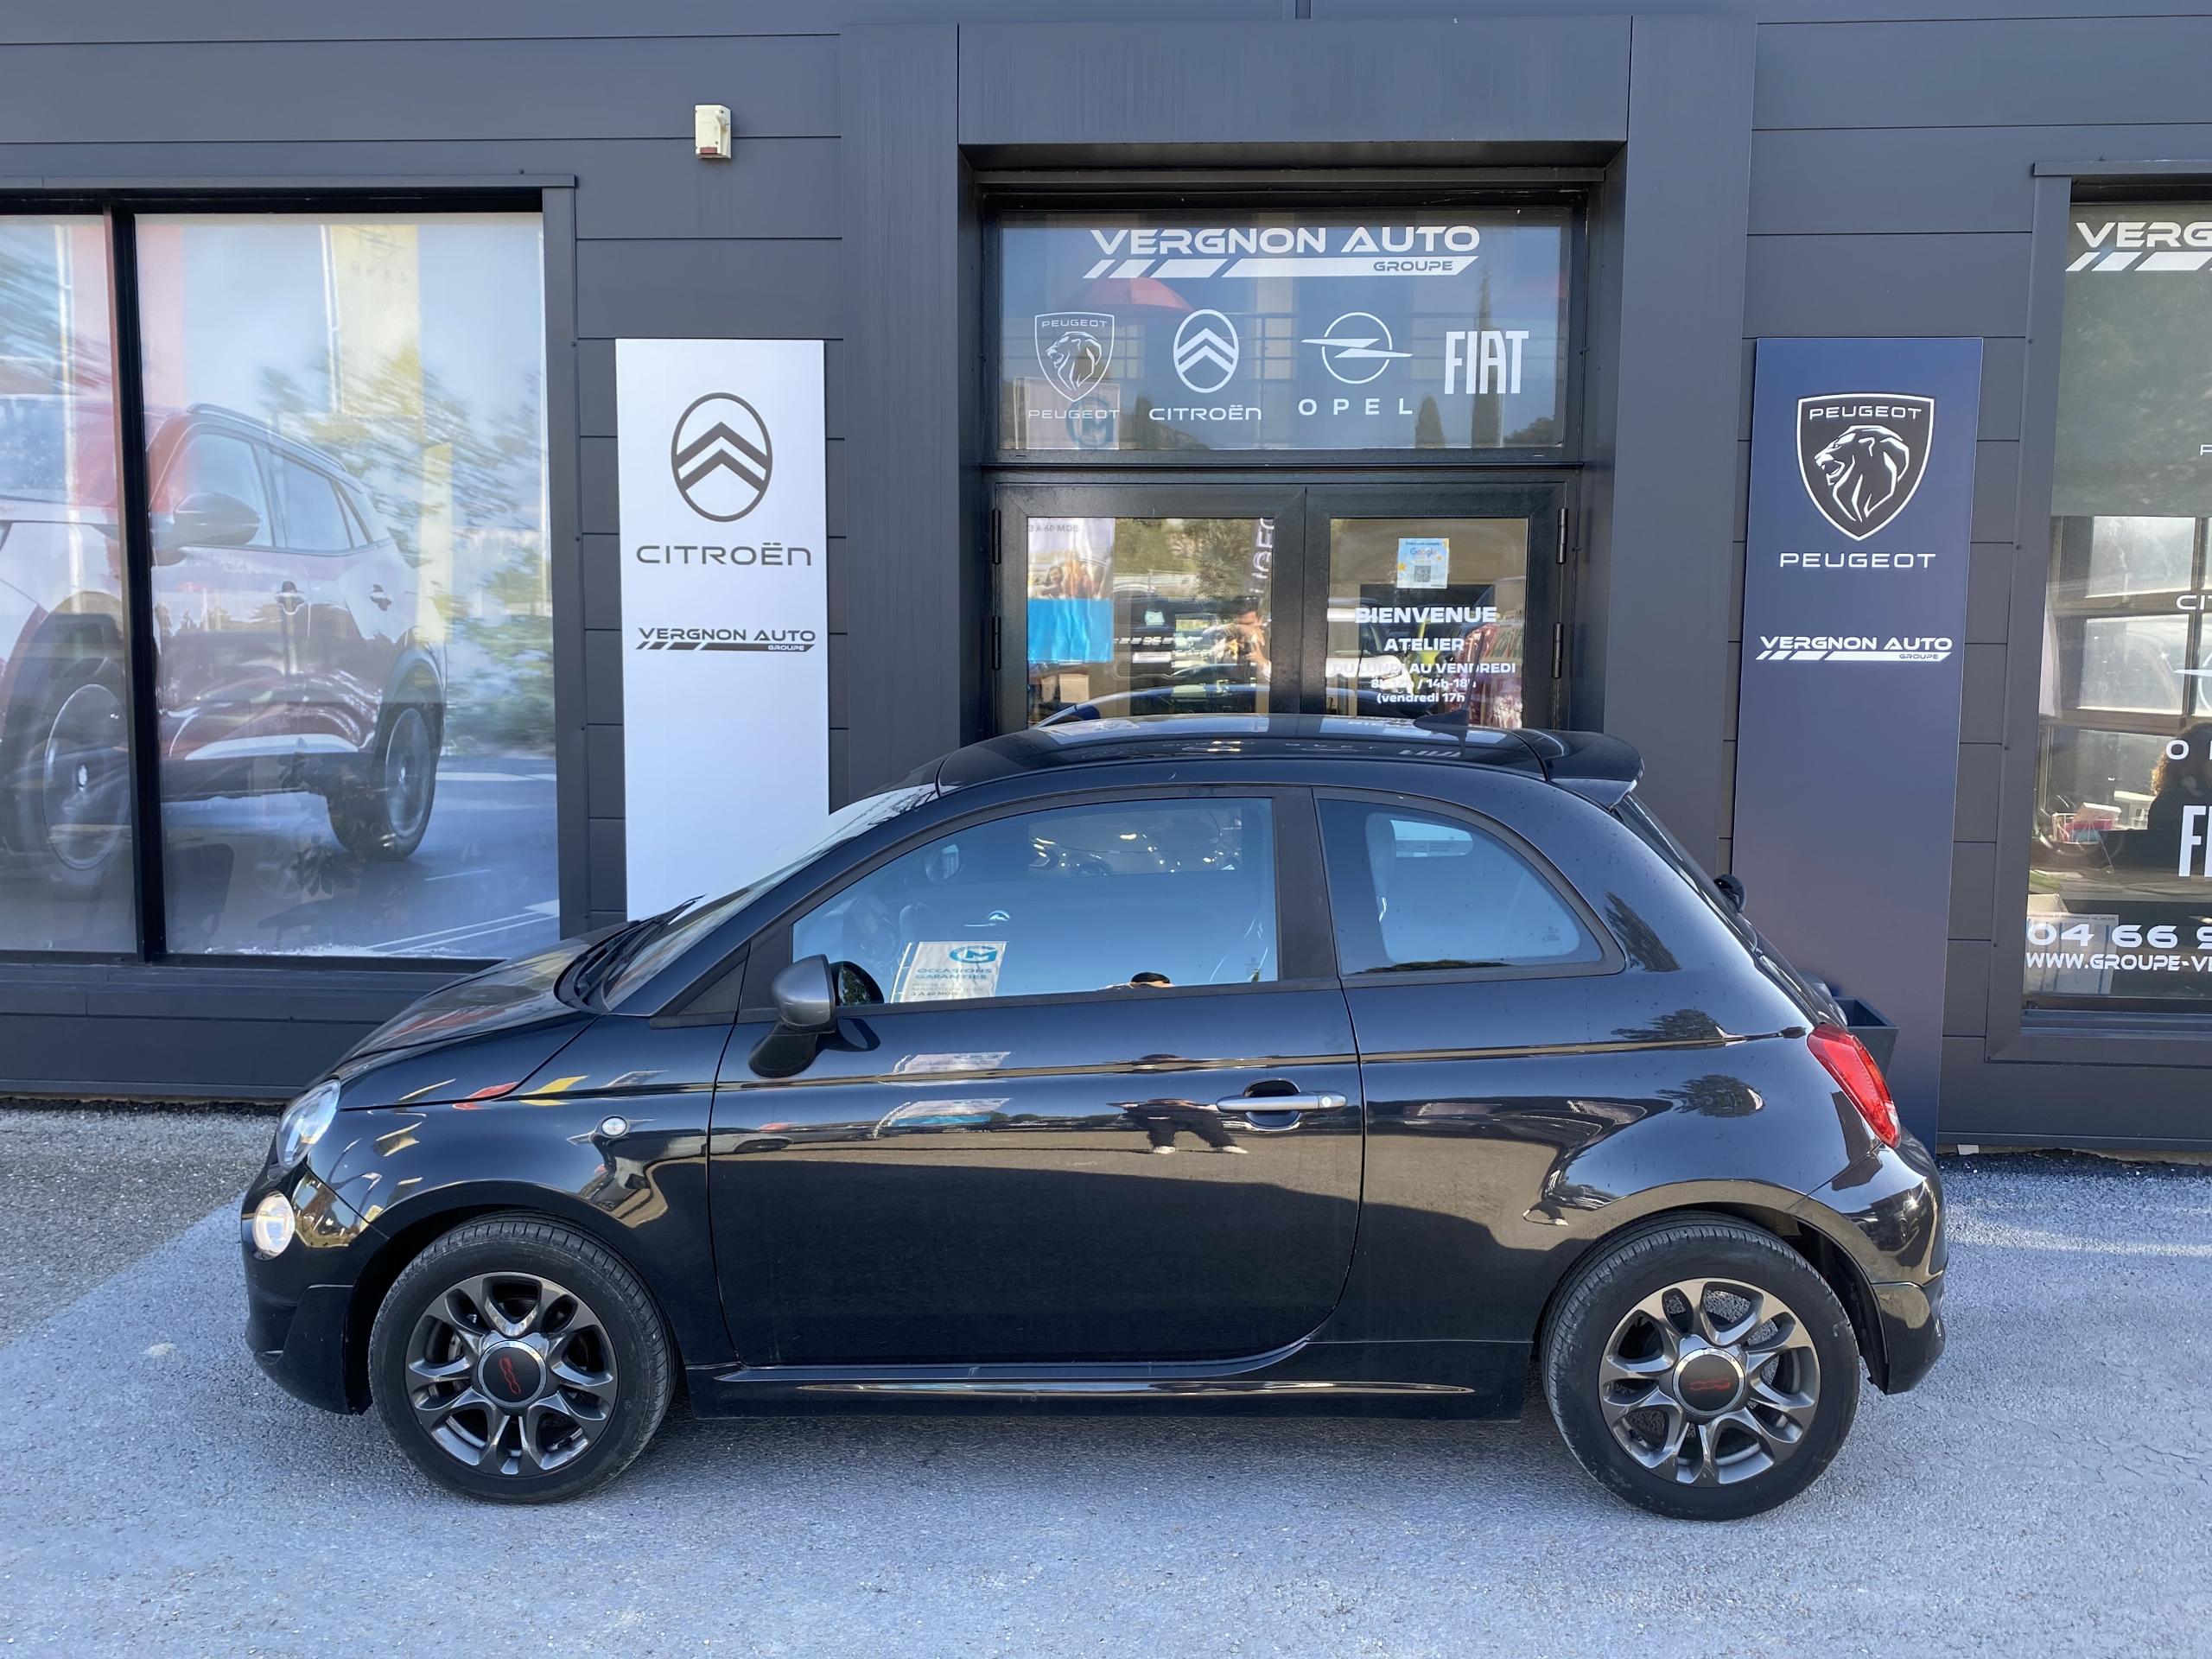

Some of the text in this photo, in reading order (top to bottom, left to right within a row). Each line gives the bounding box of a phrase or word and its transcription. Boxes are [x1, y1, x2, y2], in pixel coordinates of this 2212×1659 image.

[1090, 226, 1480, 254] VERGNON AUTO
[1374, 261, 1453, 271] GROUPE
[1041, 320, 1108, 328] PEUGEOT
[1445, 330, 1529, 395] FIAT
[1028, 410, 1120, 419] PEUGEOT
[1149, 404, 1262, 421] CITROËN
[1299, 398, 1413, 416] OPEL
[1809, 405, 1923, 420] PEUGEOT
[636, 542, 812, 566] CITROËN
[1409, 547, 1438, 557] Google
[1780, 553, 1936, 569] PEUGEOT
[1355, 607, 1497, 623] BIENVENUE
[638, 627, 817, 642] VERGNON AUTO
[1383, 638, 1465, 652] ATELIER
[1760, 636, 1953, 651] VERGNON AUTO
[1409, 663, 1432, 674] AU
[1376, 692, 1440, 704] (vendredi
[2027, 923, 2094, 947] 04
[2112, 925, 2178, 949] 66
